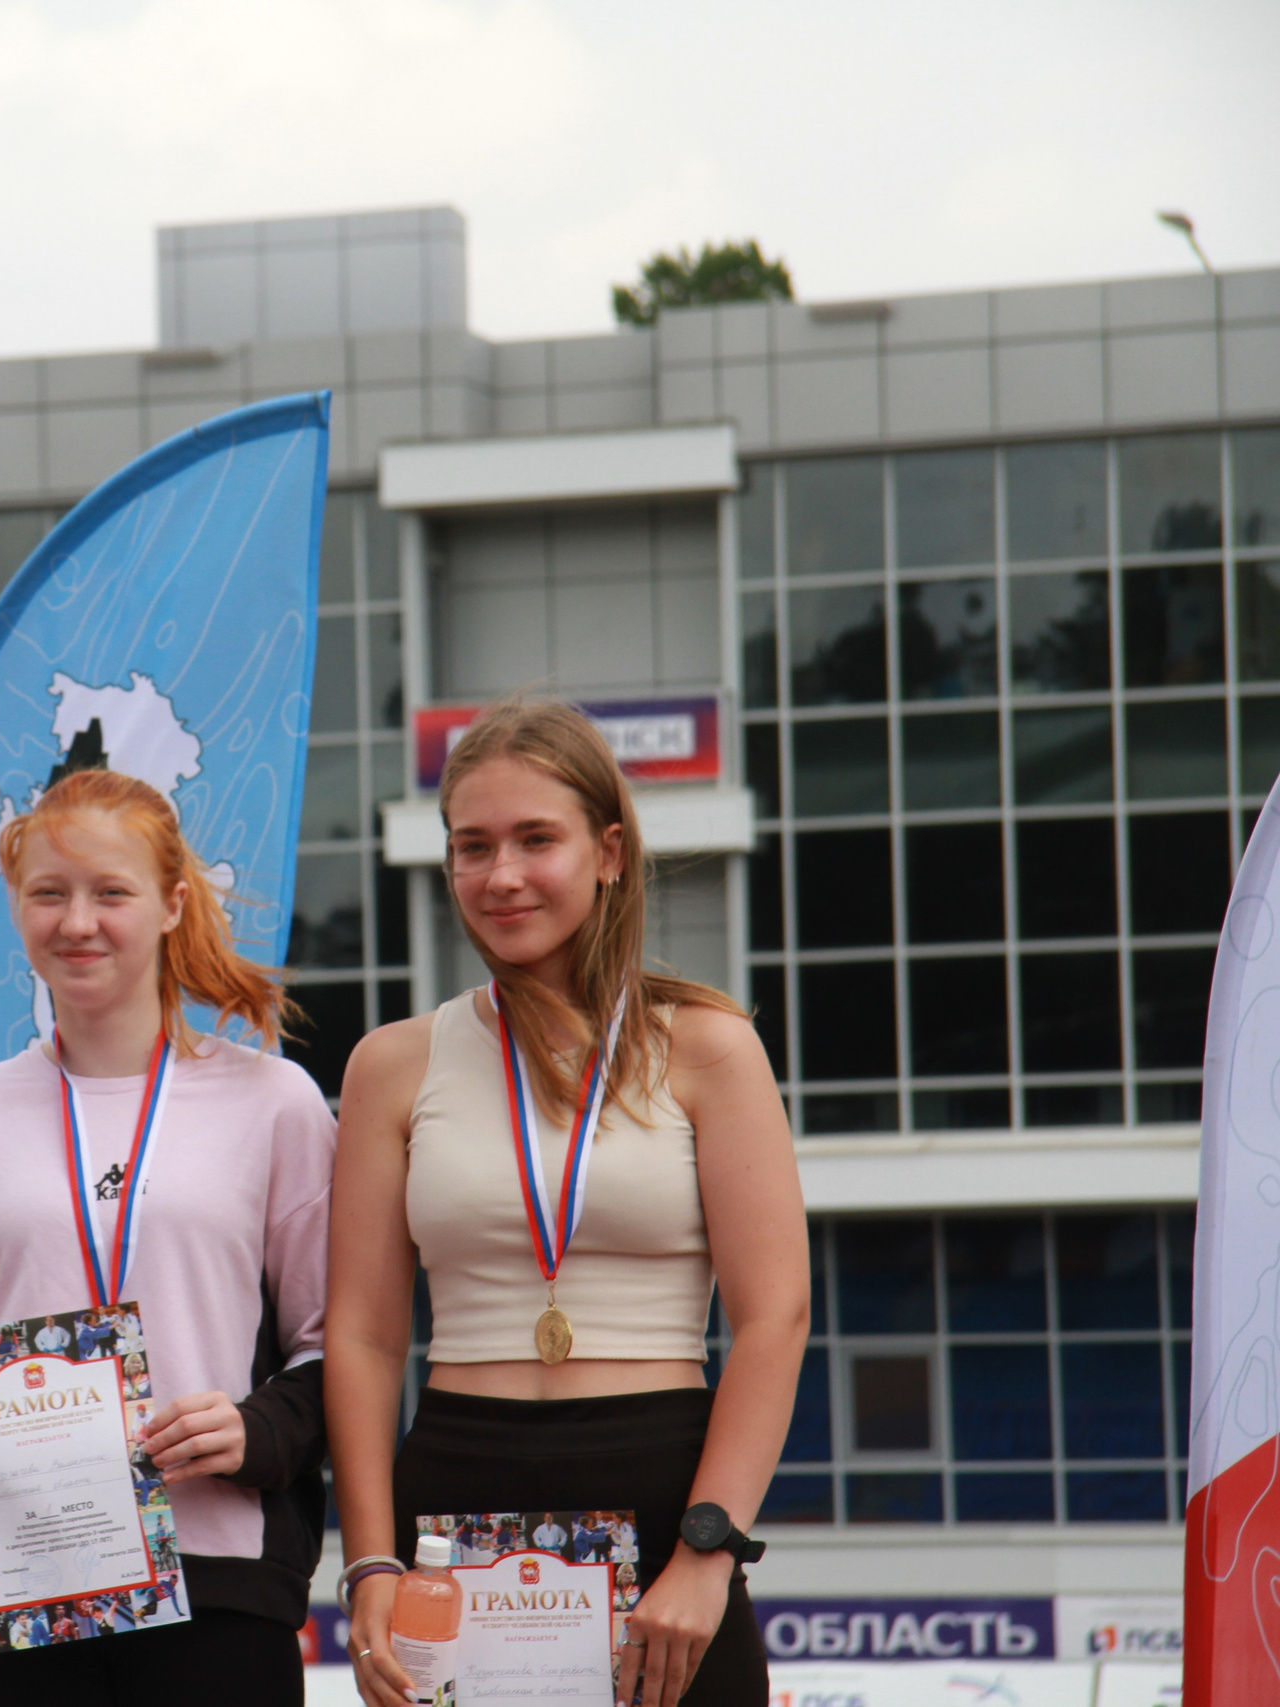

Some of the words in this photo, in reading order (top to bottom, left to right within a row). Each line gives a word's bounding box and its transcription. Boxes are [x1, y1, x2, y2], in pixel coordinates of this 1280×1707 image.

[24, 1511, 37, 1520] ЗА
[61, 1501, 94, 1514] МЕСТО
[470, 1589, 591, 1611] ГРАМОТА
[764, 1611, 1038, 1657] ОБЛАСТЬ
